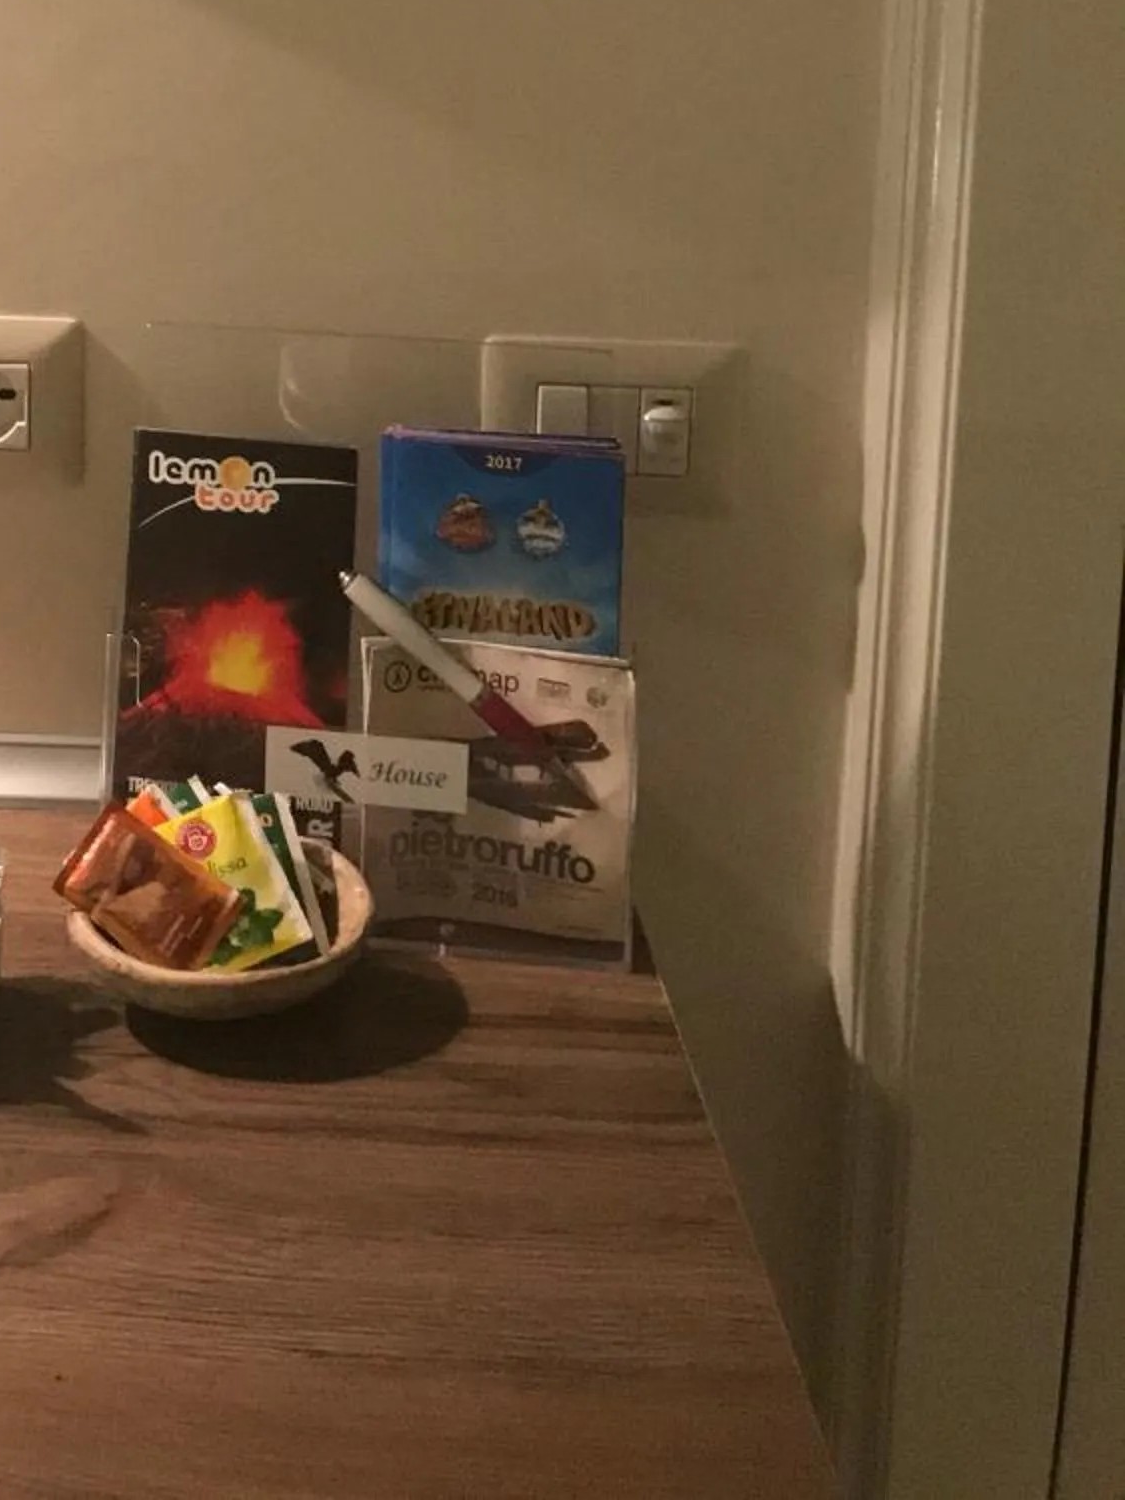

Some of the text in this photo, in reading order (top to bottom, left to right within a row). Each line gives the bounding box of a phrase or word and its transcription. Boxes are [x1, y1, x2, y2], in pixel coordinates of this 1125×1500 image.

[148, 449, 276, 490] lemon
[485, 454, 524, 472] 2017
[195, 481, 280, 514] tour
[369, 760, 449, 789] House
[389, 821, 598, 885] pietroruffo
